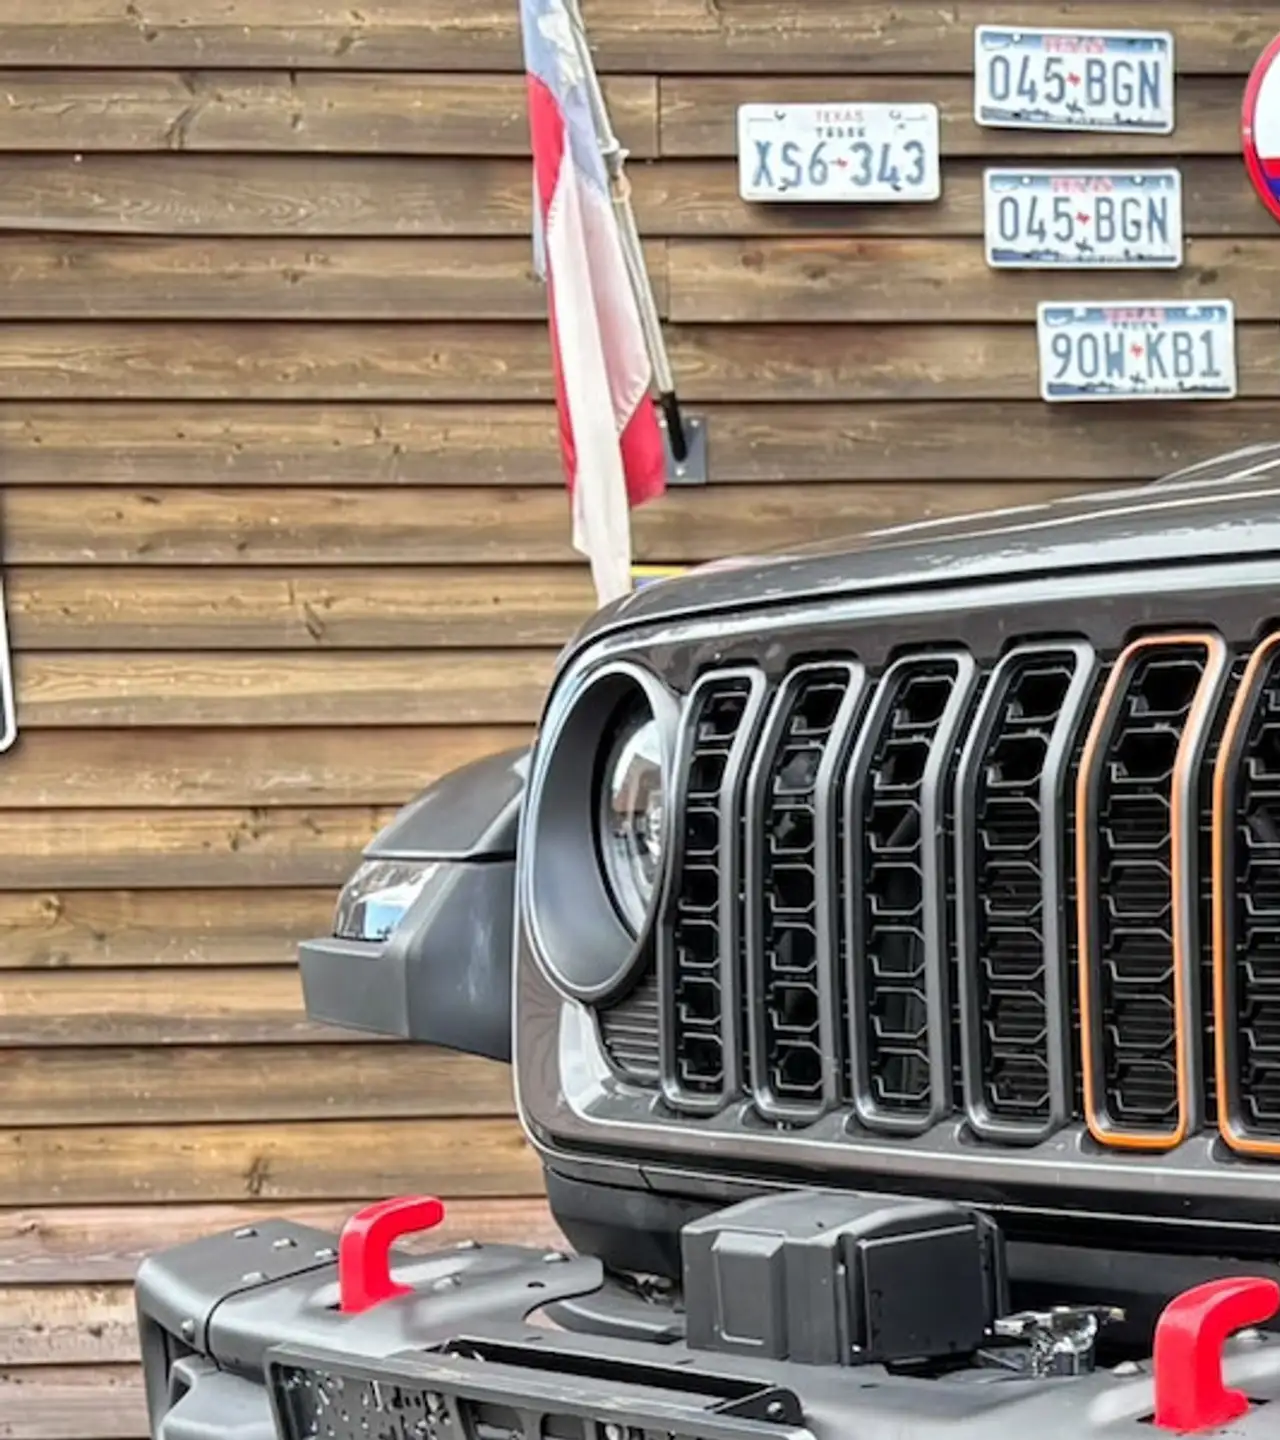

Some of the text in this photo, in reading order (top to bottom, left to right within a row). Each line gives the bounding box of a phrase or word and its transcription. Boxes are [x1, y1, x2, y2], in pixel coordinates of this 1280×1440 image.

[988, 54, 1161, 109] 045 BGN
[752, 139, 926, 187] XS6 343
[998, 195, 1169, 244] 045 BGN
[1146, 330, 1221, 378] KB1
